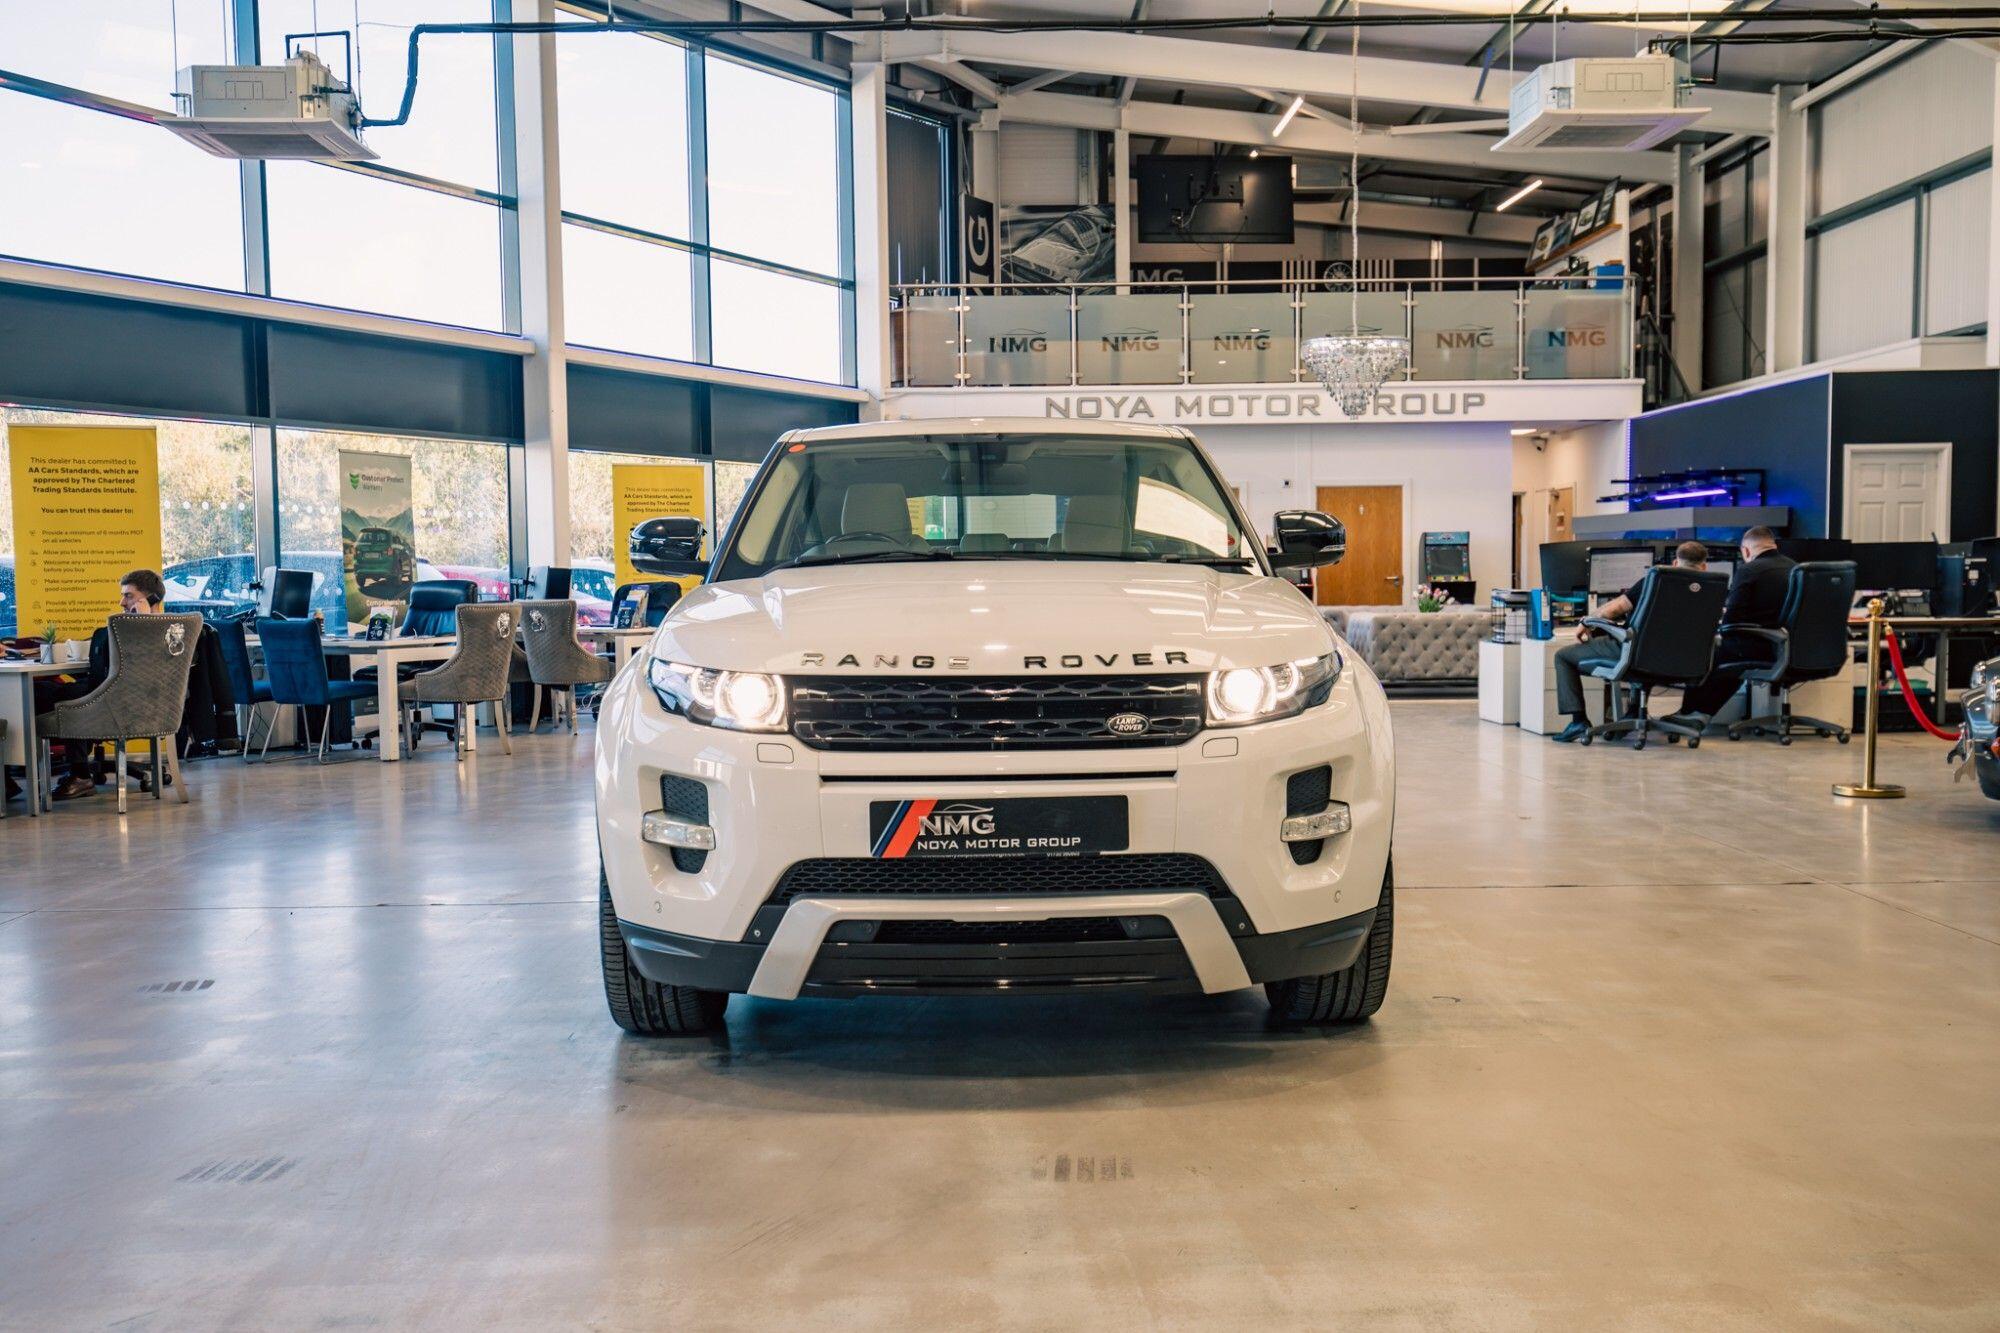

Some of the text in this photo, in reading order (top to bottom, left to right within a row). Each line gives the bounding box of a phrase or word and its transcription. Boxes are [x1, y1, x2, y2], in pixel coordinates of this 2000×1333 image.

[989, 337, 1047, 353] NMG
[1102, 336, 1160, 352] NMG
[1213, 335, 1272, 351] NMG
[1436, 332, 1494, 349] NMG
[1548, 331, 1606, 347] NMG
[1045, 392, 1487, 419] NOYA MOTOR ROUP
[30, 457, 137, 465] This dealer has committed to
[32, 486, 62, 494] Trading
[63, 486, 102, 494] Standards
[800, 650, 1190, 671] RANGE ROVER
[1116, 717, 1137, 725] LAND
[1118, 723, 1143, 731] ROVER
[917, 813, 995, 836] NMG
[917, 837, 1081, 851] NOYA MOTOR GROUP
